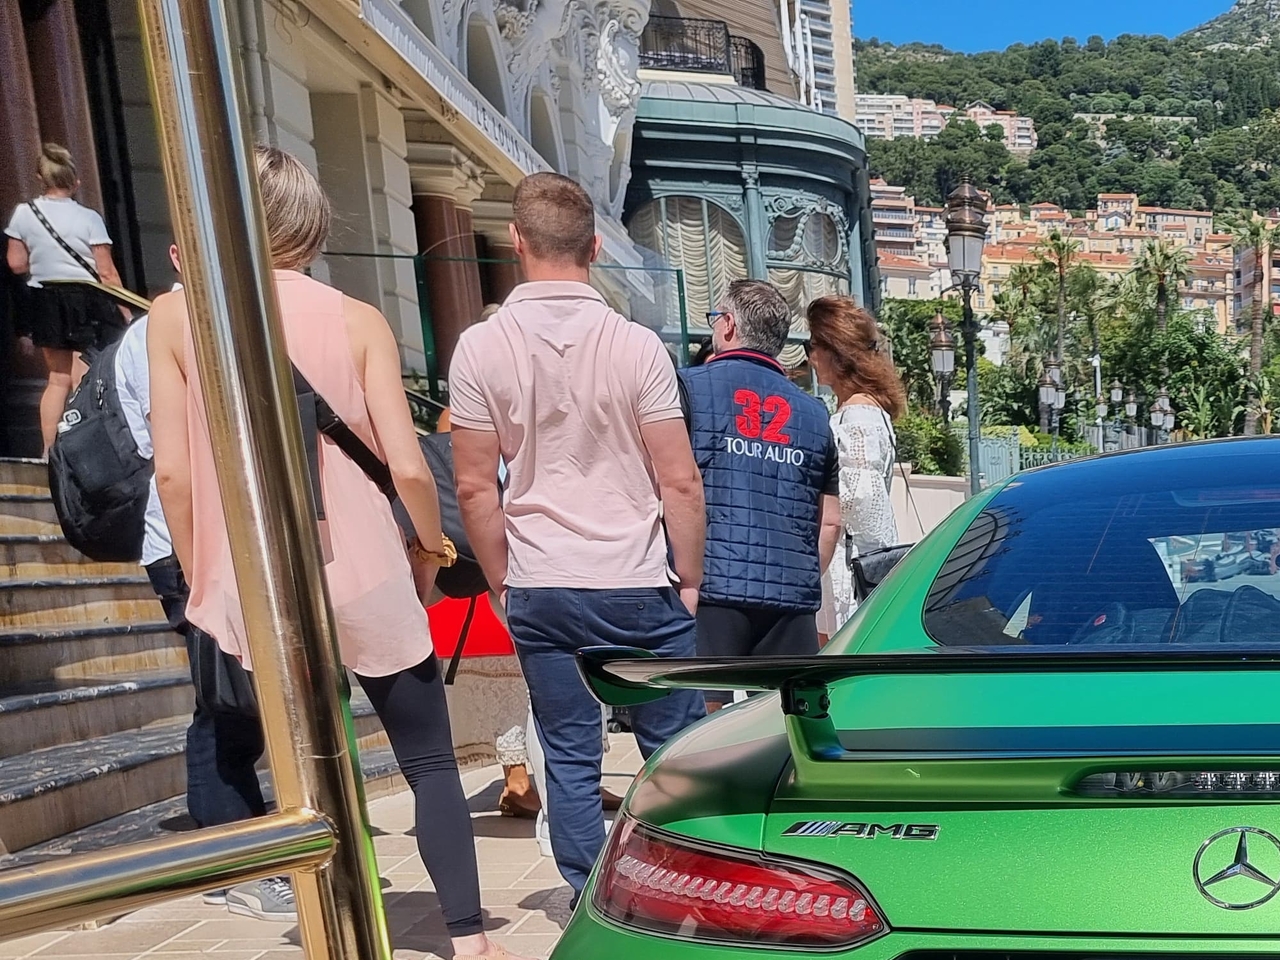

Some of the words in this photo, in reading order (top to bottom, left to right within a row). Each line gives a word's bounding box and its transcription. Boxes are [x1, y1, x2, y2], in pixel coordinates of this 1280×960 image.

[734, 389, 791, 444] 32
[724, 437, 762, 459] TOUR
[764, 445, 804, 466] AUTO
[829, 822, 941, 842] AMG
